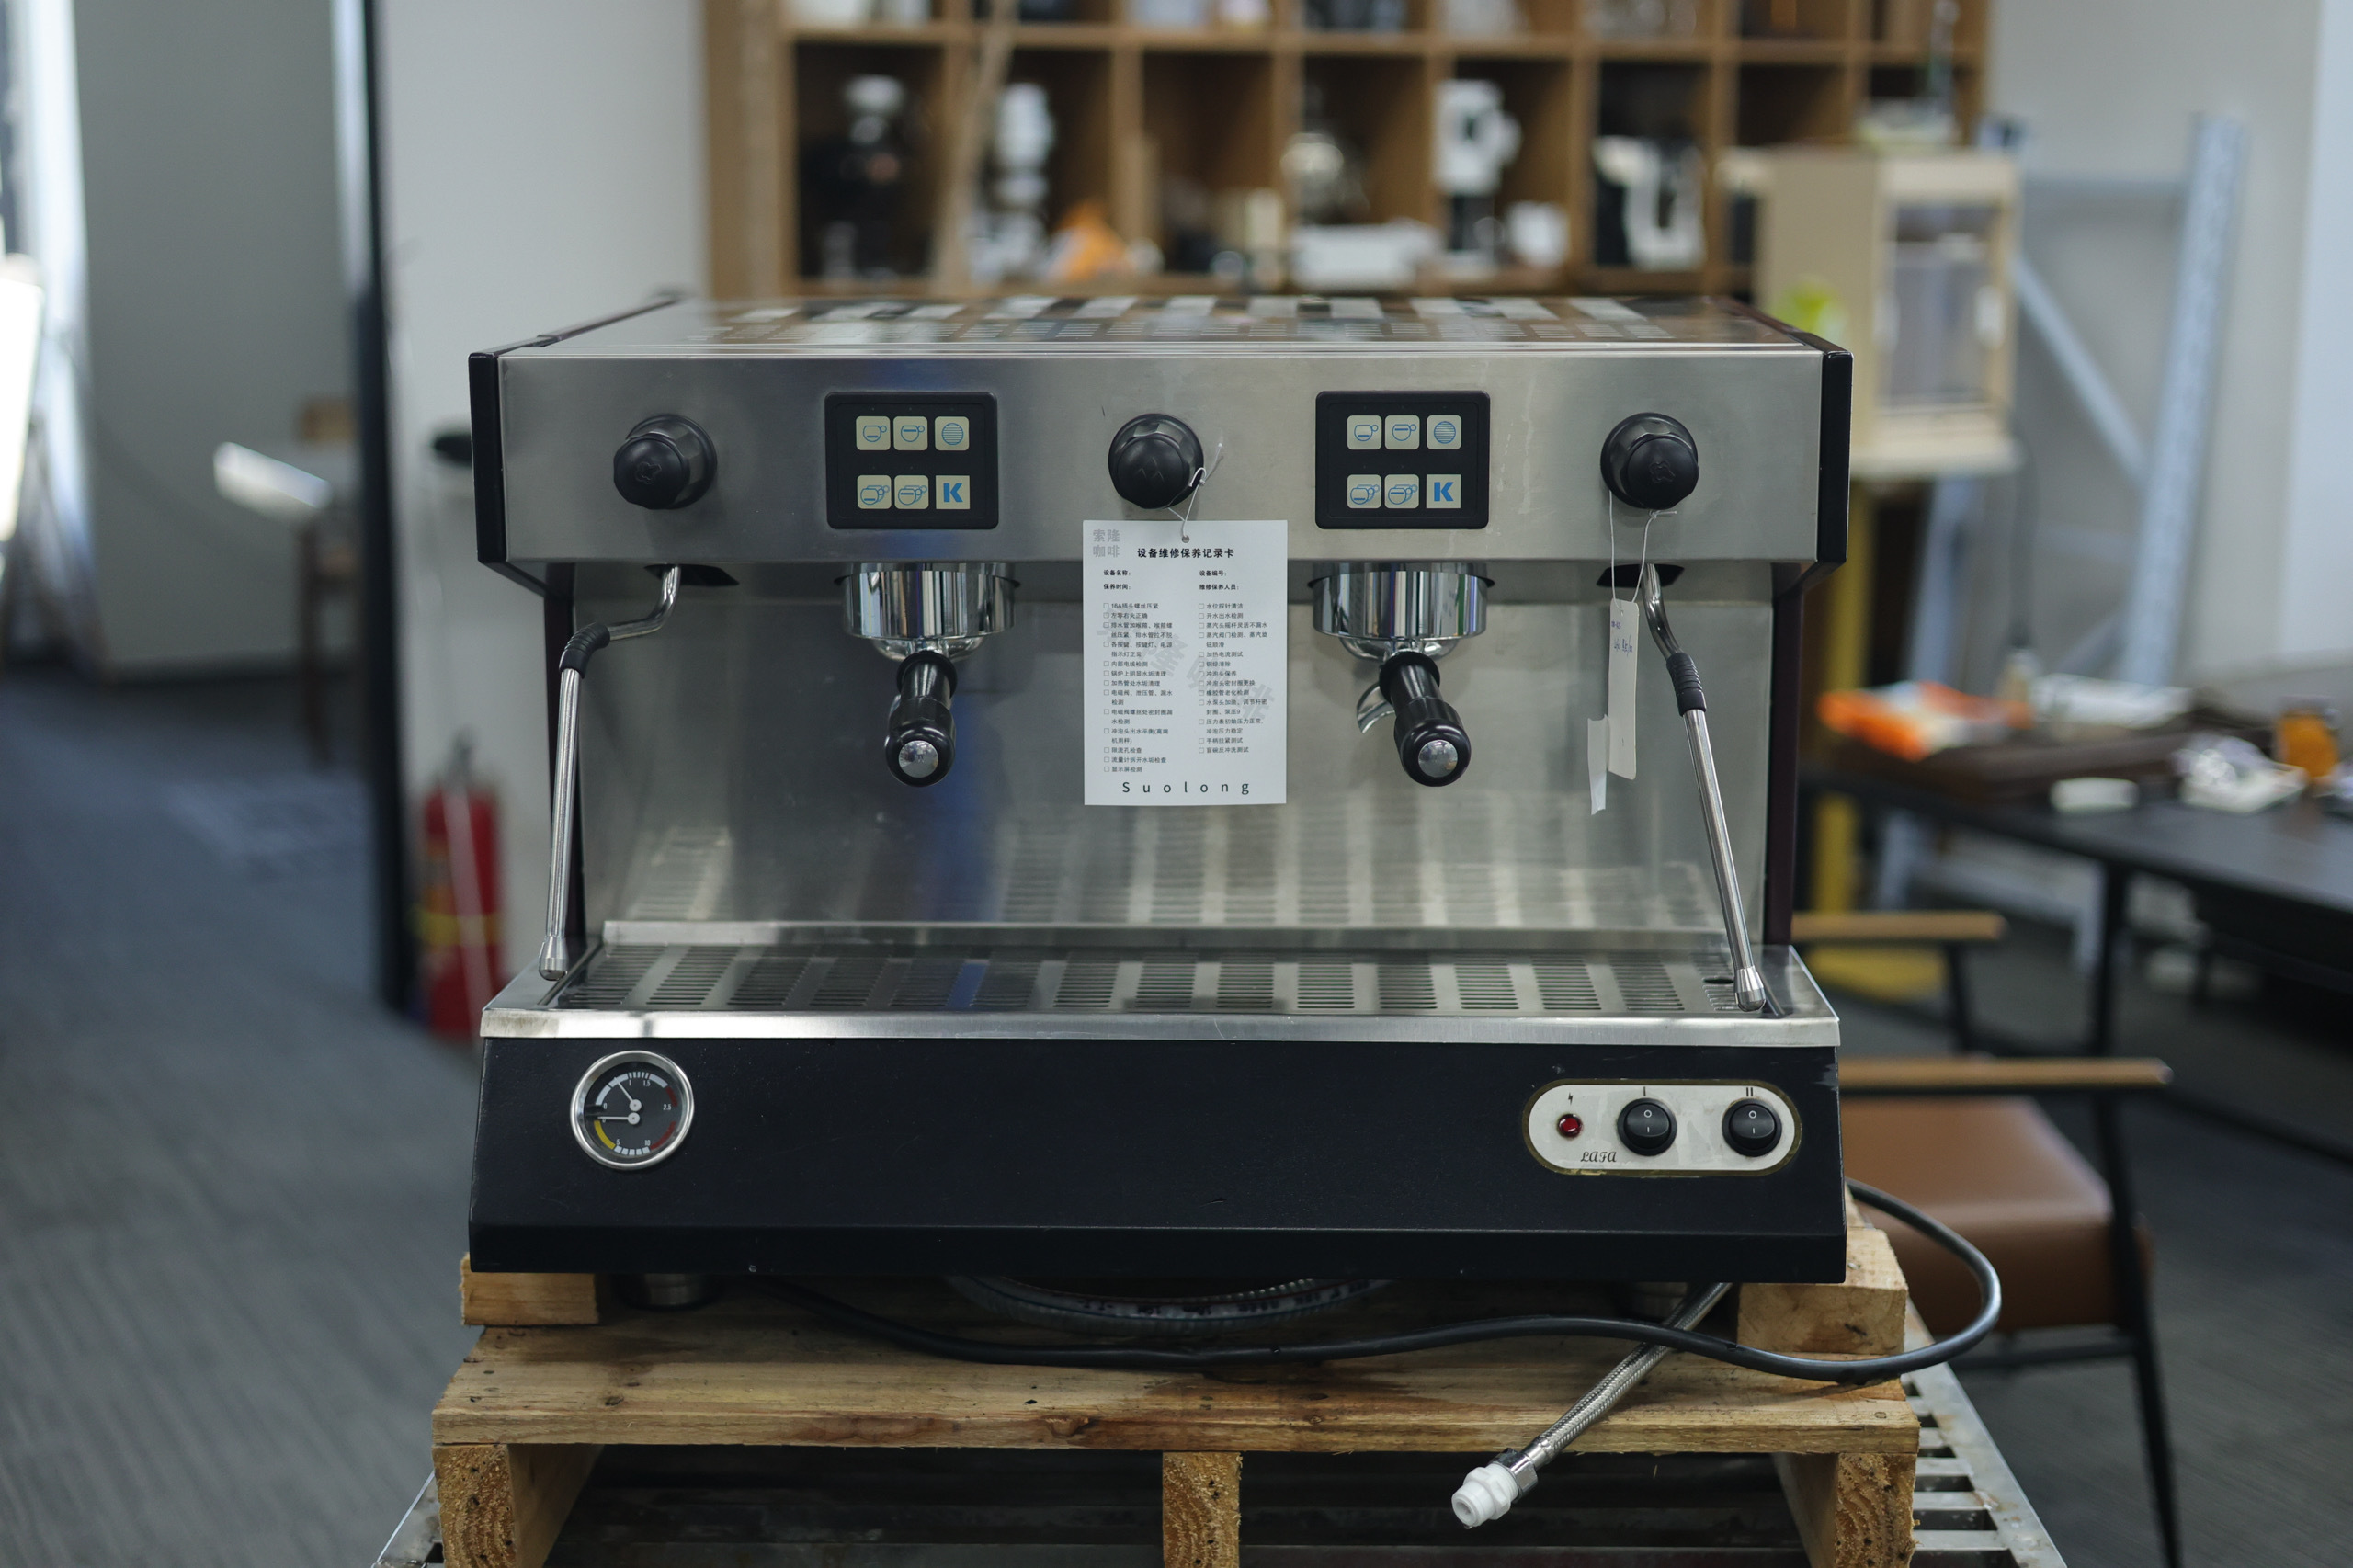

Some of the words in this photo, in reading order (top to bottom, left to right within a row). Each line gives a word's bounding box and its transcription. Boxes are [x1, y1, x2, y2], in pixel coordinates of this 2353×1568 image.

[943, 483, 963, 503] K
[1433, 482, 1454, 502] K
[1093, 528, 1120, 543] 索隆
[1092, 544, 1120, 559] 咖啡
[1136, 547, 1235, 559] 设备维修保养记录卡
[1580, 1151, 1618, 1163] LAFA
